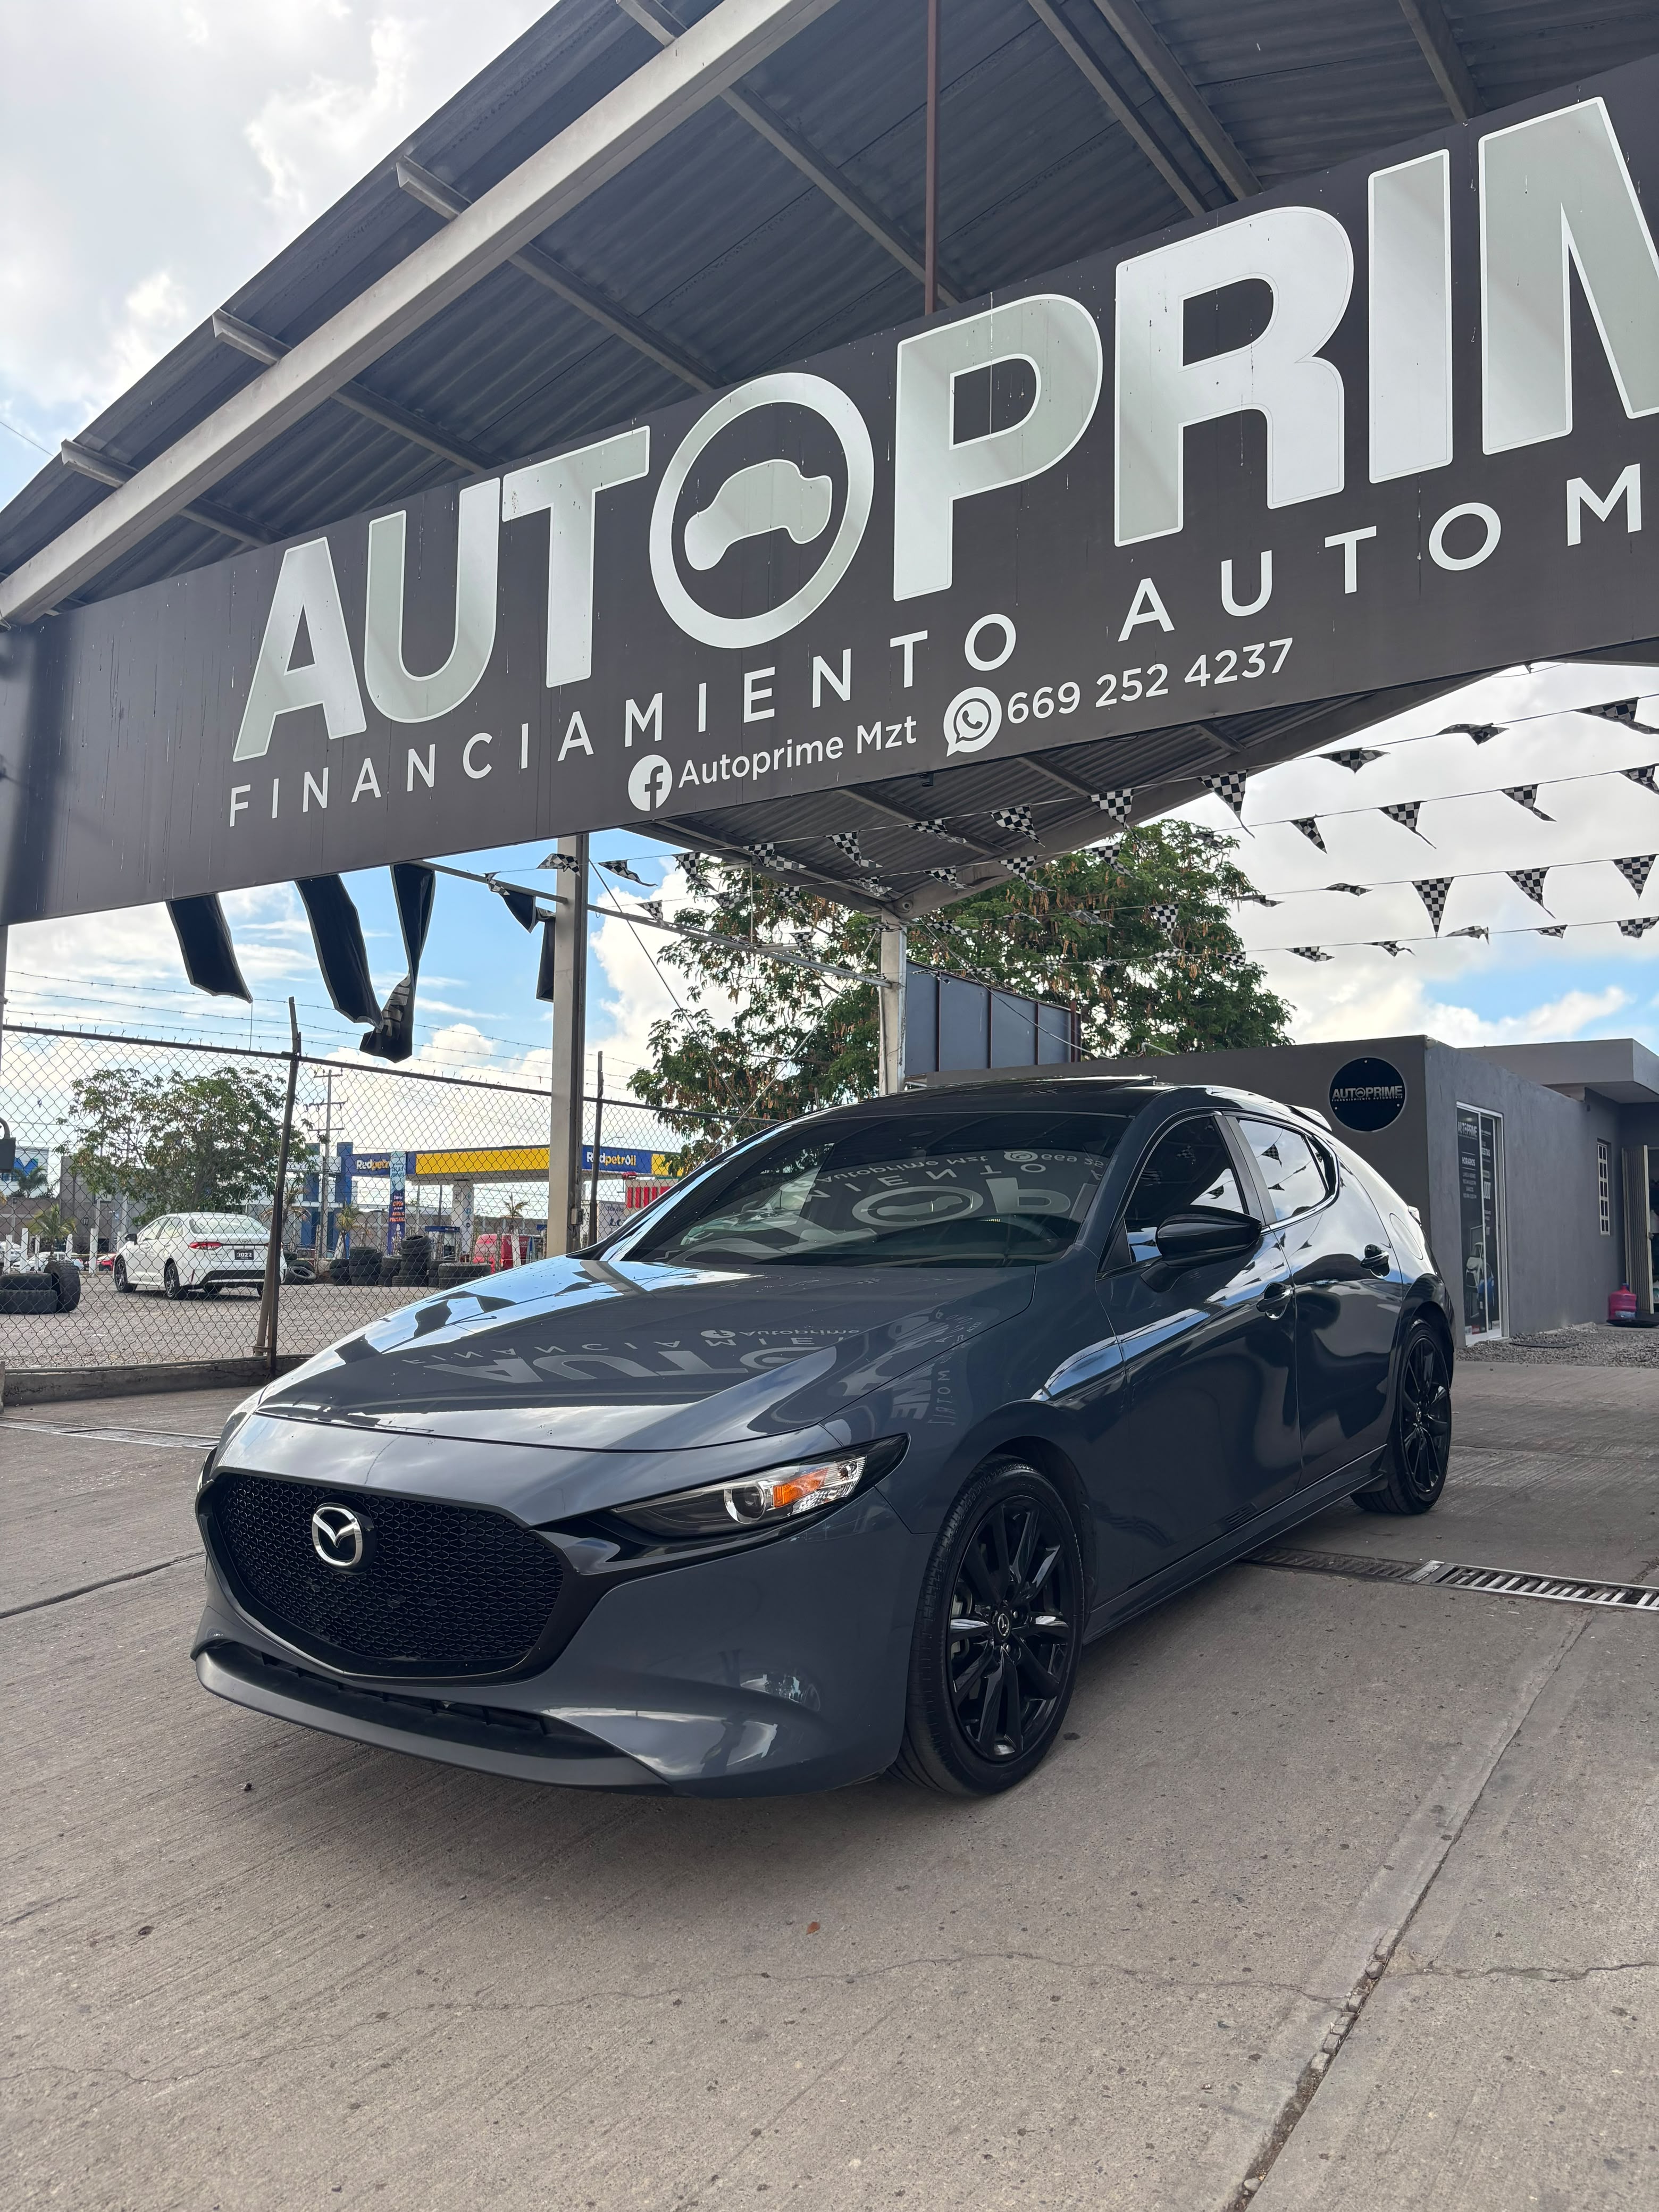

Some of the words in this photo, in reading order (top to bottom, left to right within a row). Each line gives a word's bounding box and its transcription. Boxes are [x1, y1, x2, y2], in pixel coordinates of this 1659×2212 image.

[229, 613, 1016, 827] FINANCIAMIENTO
[1008, 682, 1080, 724] 669
[1095, 663, 1168, 708] 252
[1184, 637, 1293, 687] 4237
[678, 734, 844, 788] Autoprime
[857, 716, 917, 754] Mzt
[1332, 1085, 1403, 1099] AUTOPRIME
